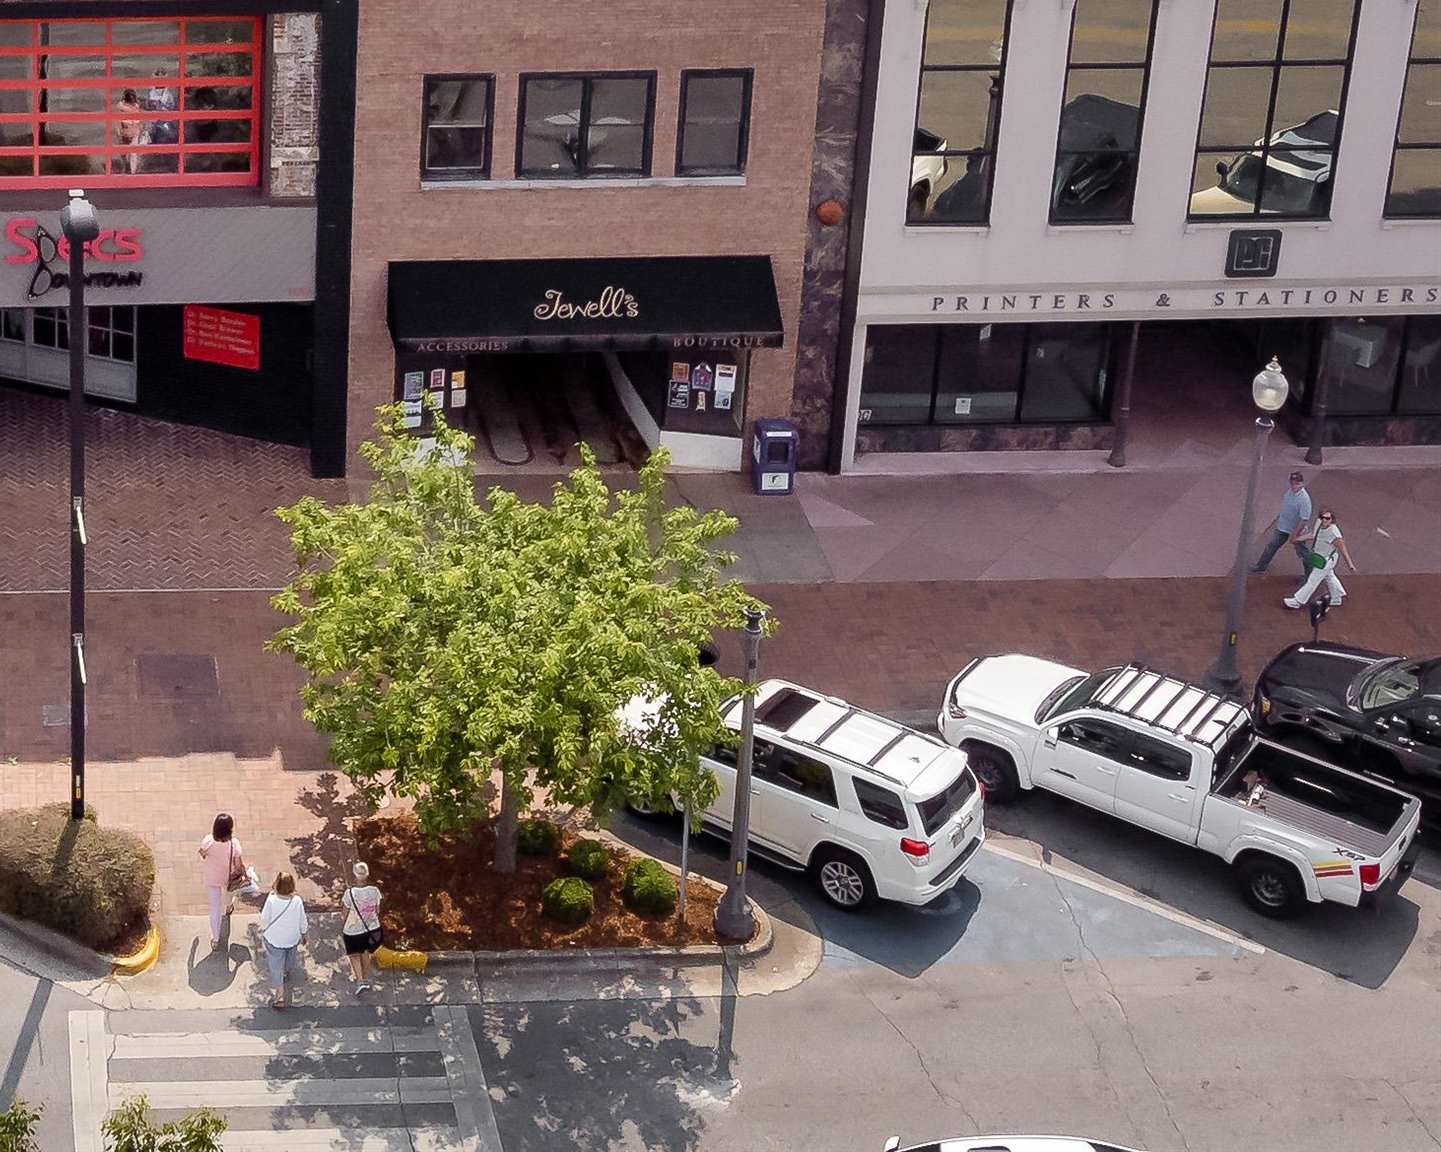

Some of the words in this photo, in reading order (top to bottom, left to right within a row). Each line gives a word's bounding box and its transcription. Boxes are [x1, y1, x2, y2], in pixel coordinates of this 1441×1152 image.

[534, 286, 639, 320] Jewell's
[932, 294, 1116, 311] PRINTERS
[1155, 293, 1171, 307] &
[1214, 287, 1438, 306] STATIONERS
[416, 342, 509, 352] ACCESSORIES
[673, 335, 765, 348] BOUTIQUE
